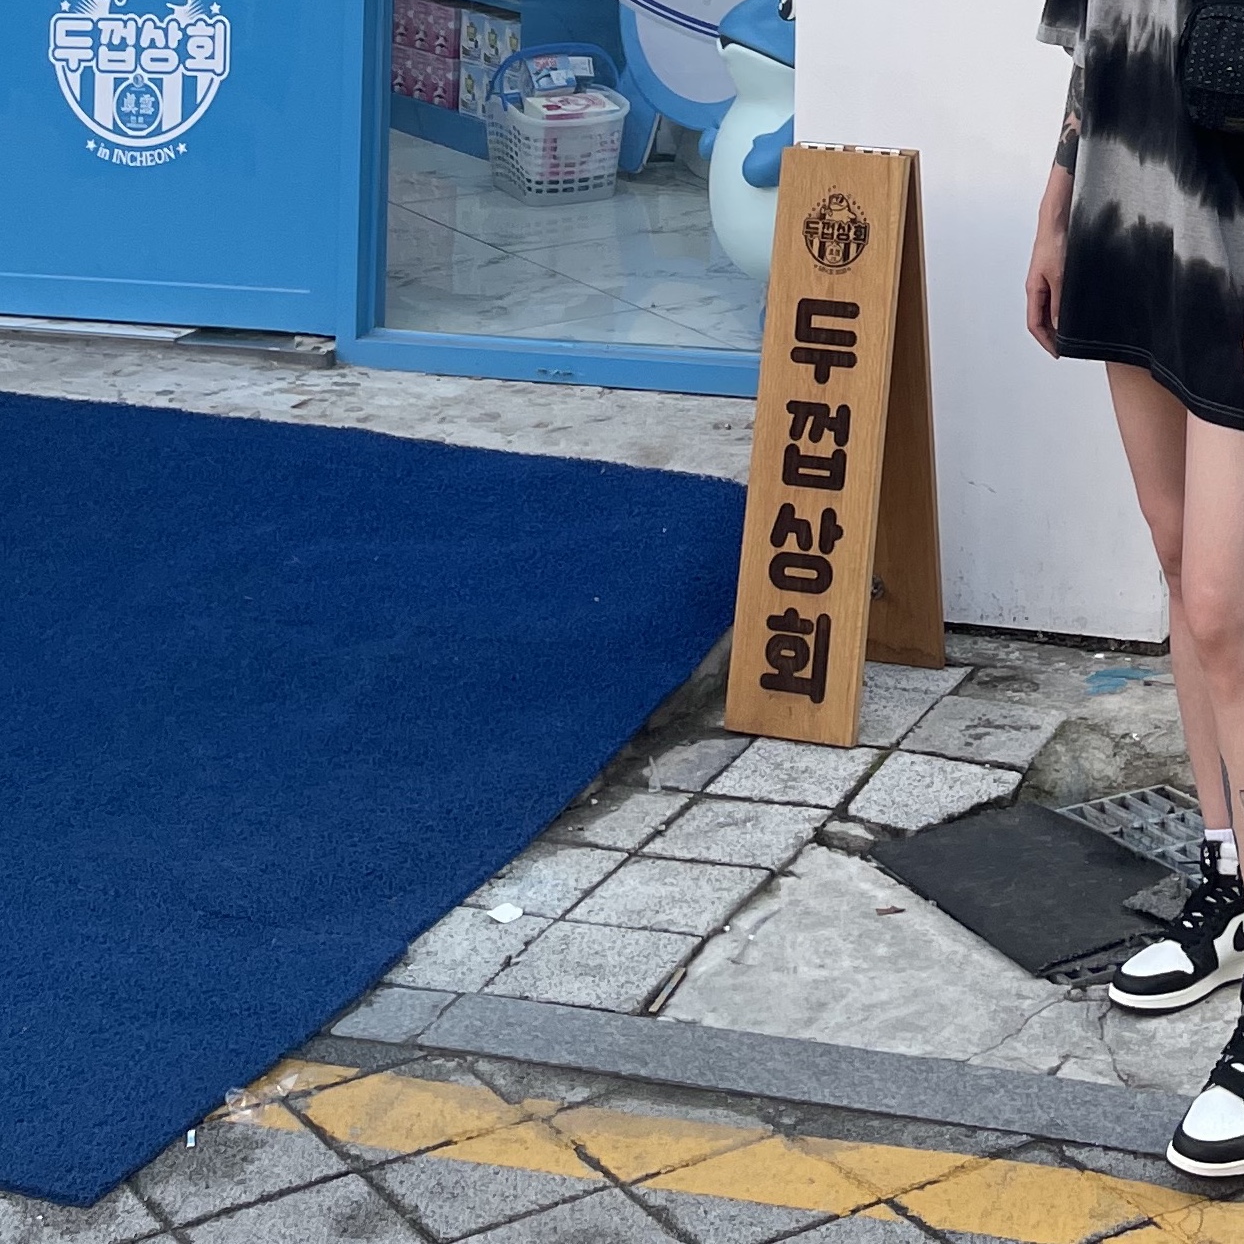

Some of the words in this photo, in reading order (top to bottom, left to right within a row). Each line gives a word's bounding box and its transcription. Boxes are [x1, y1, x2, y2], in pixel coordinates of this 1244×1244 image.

[54, 17, 227, 75] 두껍상회
[96, 142, 110, 161] in
[111, 144, 176, 167] INCHEON
[803, 219, 868, 244] 두껍상회
[758, 296, 860, 705] 두껍상회
